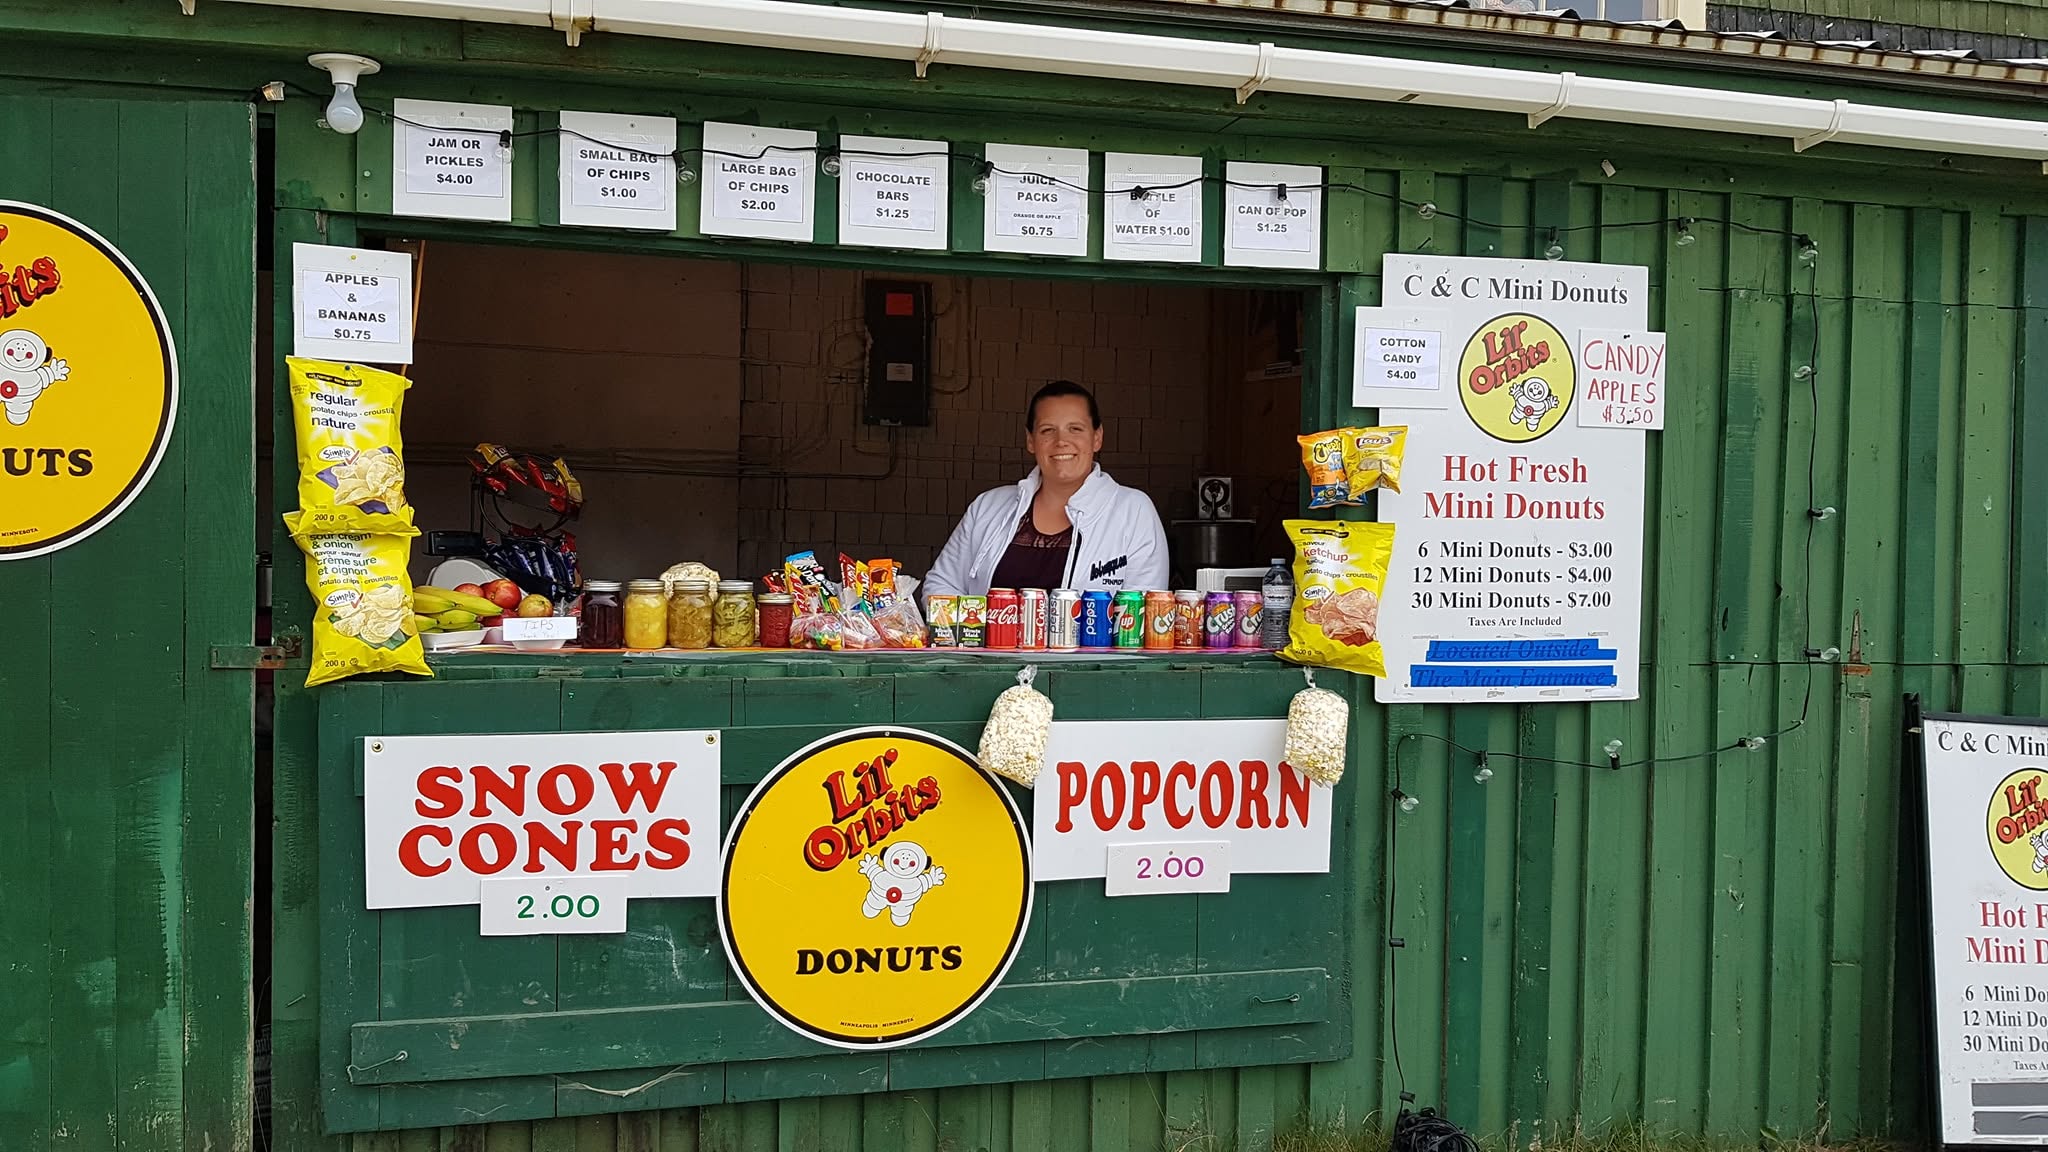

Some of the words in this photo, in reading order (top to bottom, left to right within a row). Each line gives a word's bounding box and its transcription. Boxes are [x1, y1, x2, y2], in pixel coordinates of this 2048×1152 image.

[428, 137, 458, 149] JAM
[461, 138, 481, 150] OR
[425, 155, 484, 168] PICKLES
[579, 149, 625, 162] SMALL
[629, 152, 659, 164] BAG
[587, 167, 608, 179] OF
[609, 169, 651, 182] CHIPS
[721, 162, 767, 176] LARGE
[769, 165, 797, 178] BAG
[436, 173, 473, 185] $4.00
[856, 171, 931, 187] CHOCOLATE
[1019, 175, 1056, 187] JUICE
[601, 187, 637, 199] $1.00
[728, 180, 748, 192] OF
[749, 182, 790, 195] CHIPS
[876, 190, 910, 202] BARS
[1017, 191, 1058, 203] PACKS
[741, 199, 776, 212] $2.00
[1238, 205, 1264, 216] CAN
[1265, 206, 1281, 216] OF
[1283, 207, 1307, 218] POP
[876, 207, 909, 219] $1.25
[1013, 212, 1035, 220] ORANGE
[1145, 208, 1161, 219] OF
[1021, 225, 1053, 237] $0.75
[1115, 225, 1157, 236] WATER
[1159, 226, 1191, 237] $1.00
[1257, 222, 1288, 234] $1.25
[325, 273, 379, 286] APPLES
[1404, 274, 1423, 297] C
[1431, 275, 1452, 298] &
[1461, 276, 1480, 299] C
[1488, 277, 1542, 301] Mini
[1550, 280, 1629, 305] Donuts
[347, 293, 357, 303] &
[318, 309, 386, 323] BANANAS
[334, 328, 371, 340] $0.75
[1380, 337, 1426, 348] COTTON
[1482, 320, 1528, 366] Lil'
[1383, 354, 1422, 364] CANDY
[1584, 340, 1665, 378] CANDY
[1469, 340, 1551, 395] Orbits
[1386, 370, 1417, 380] $4.00
[1587, 378, 1657, 405] APPLES
[310, 391, 358, 407] regular
[310, 406, 336, 415] potato
[336, 410, 358, 419] chips
[1602, 404, 1654, 425] $3.50
[311, 416, 356, 430] nature
[1442, 455, 1499, 482] Hot
[1508, 456, 1589, 483] Fresh
[1423, 492, 1494, 519] Mini
[1503, 492, 1606, 520] Donuts
[314, 513, 328, 521] 200
[2, 527, 39, 537] MINNESOTA
[339, 532, 372, 541] cream
[311, 540, 321, 549] &
[323, 540, 354, 550] onion
[1418, 541, 1429, 558] 6
[1439, 541, 1483, 558] Mini
[1488, 541, 1552, 559] Donuts
[1568, 541, 1614, 559] $3.00
[353, 557, 377, 567] sure
[1303, 548, 1349, 563] ketchup
[317, 566, 329, 576] et
[331, 566, 368, 576] oignon
[1303, 568, 1323, 576] potato
[1323, 571, 1341, 579] chips
[1413, 567, 1433, 583] 12
[1438, 566, 1483, 584] Mini
[1488, 566, 1552, 584] Donuts
[1567, 566, 1613, 584] $4.00
[319, 577, 342, 587] potato
[364, 575, 399, 585] croustilles
[1411, 592, 1433, 609] 30
[1438, 592, 1483, 609] Mini
[1487, 591, 1551, 609] Donuts
[1567, 591, 1612, 609] $7.00
[1035, 599, 1045, 627] Coke
[1085, 597, 1097, 636] pepsi
[524, 619, 554, 631] TIPS
[1467, 617, 1497, 627] Taxes
[1498, 617, 1518, 627] Are
[1519, 616, 1562, 627] Included
[1430, 640, 1512, 660] Located
[1517, 639, 1591, 658] Outside
[325, 659, 339, 667] 200
[1414, 669, 1451, 687] The
[1938, 731, 1953, 752] C
[1960, 732, 1978, 752] &
[1984, 733, 2000, 754] C
[415, 762, 678, 818] SNOW
[823, 748, 899, 824] Lil'
[1055, 760, 1311, 833] POPCORN
[803, 776, 942, 872] Orbits
[398, 818, 691, 877] CONES
[1136, 856, 1205, 880] 2.00
[516, 895, 601, 920] 2.00
[1979, 902, 2028, 928] Hot
[1965, 937, 2027, 964] Mini
[795, 945, 963, 975] DONUTS
[1965, 985, 1974, 1002] 6
[1984, 985, 2020, 1002] Mini
[839, 1021, 878, 1029] MINNEAPOLIS
[882, 1017, 914, 1028] MINNESOTA
[1962, 1010, 1981, 1027] 12
[1985, 1010, 2022, 1027] Mini
[1963, 1035, 1982, 1052] 30
[1987, 1035, 2024, 1053] Mini
[2013, 1060, 2038, 1071] Taxes
